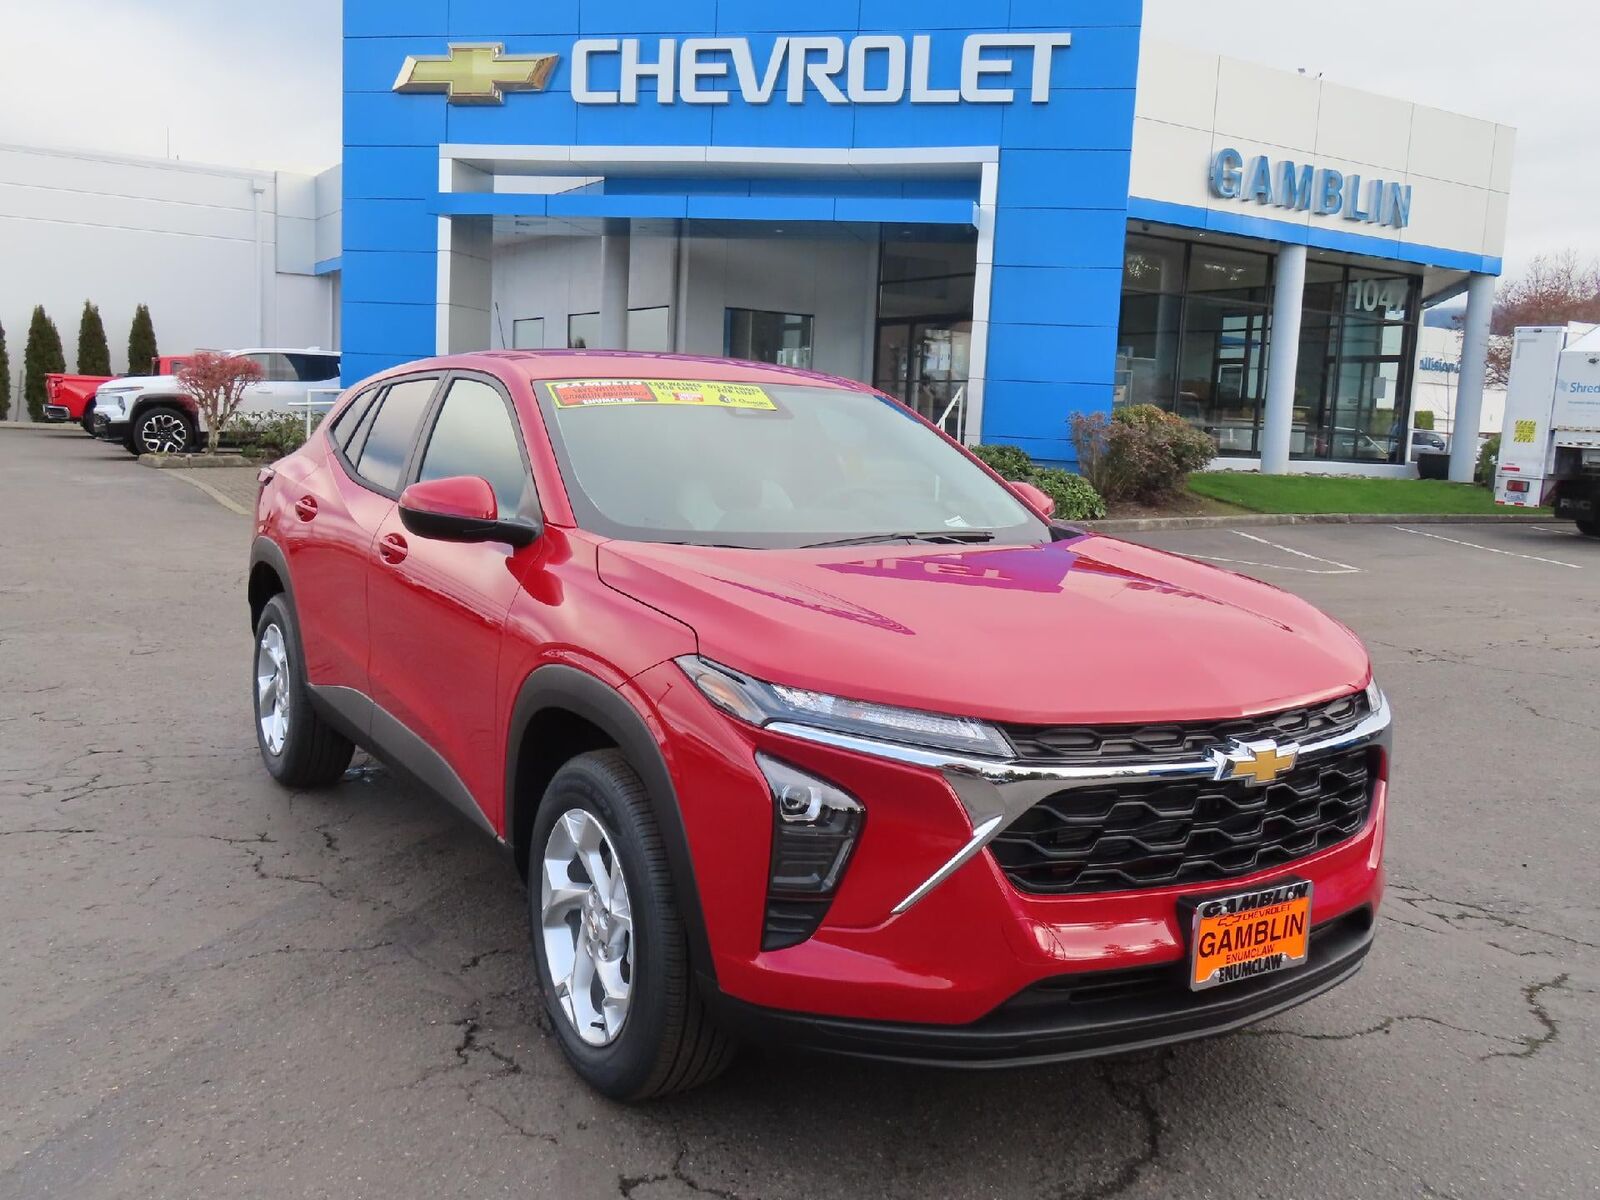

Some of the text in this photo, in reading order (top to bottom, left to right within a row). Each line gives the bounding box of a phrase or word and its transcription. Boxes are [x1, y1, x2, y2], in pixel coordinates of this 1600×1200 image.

[571, 33, 1071, 105] CHEVROLET
[1210, 148, 1412, 229] GAMBLIN
[1203, 883, 1310, 917] GAMBLIN
[1243, 903, 1292, 921] CHEVROLET
[1199, 911, 1305, 958] GAMBLIN
[1218, 953, 1283, 982] ENUMCLAW
[1226, 944, 1275, 964] ENUMCLAW
